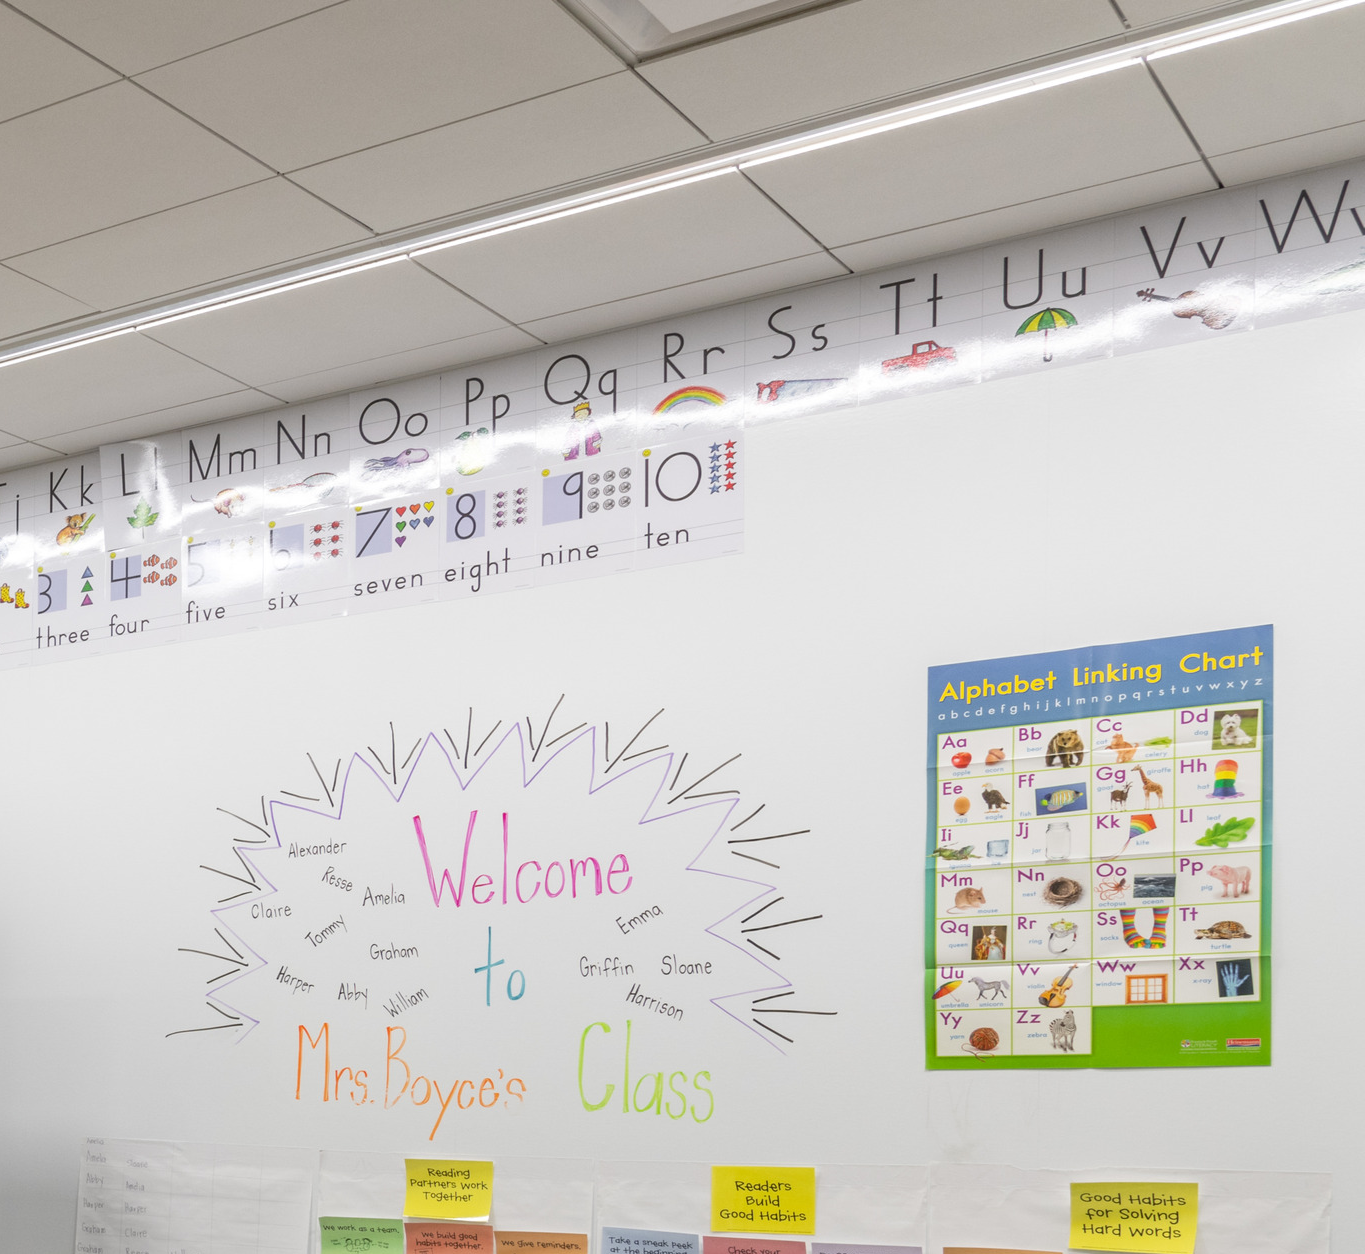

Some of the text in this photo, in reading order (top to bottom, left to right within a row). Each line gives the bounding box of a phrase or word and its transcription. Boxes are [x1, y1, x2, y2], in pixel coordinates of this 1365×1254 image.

[1139, 216, 1225, 280] Vv
[1003, 248, 1088, 310] Uu
[879, 273, 944, 336] Tt
[663, 332, 725, 383] Rr
[189, 434, 257, 482] Mm
[49, 465, 94, 513] Kk
[644, 451, 702, 508] 10
[644, 521, 690, 549] ten
[541, 543, 599, 567] nine
[444, 547, 511, 592] eight
[354, 571, 423, 596] seven
[186, 600, 226, 625] five
[268, 592, 299, 611] six
[109, 613, 150, 637] four
[37, 626, 90, 650] three
[938, 646, 1263, 704] Alphabet Linking Chart
[942, 736, 967, 748] Aa
[1019, 727, 1042, 740] Bb
[1180, 759, 1207, 773] Hh
[288, 838, 346, 858] Alexander
[413, 810, 633, 907] Welcome
[322, 866, 353, 891] Resse
[363, 883, 405, 906] Amelia
[251, 903, 292, 919] Claire
[615, 904, 663, 936] Emma
[1018, 916, 1037, 929] Rr
[305, 915, 347, 947] Tommy
[370, 943, 418, 960] Graham
[473, 925, 527, 1006] to
[579, 956, 635, 978] Griffin
[660, 956, 713, 976] Sloane
[276, 966, 314, 994] Harper
[338, 983, 368, 1010] Abby
[383, 988, 429, 1017] William
[625, 983, 684, 1020] Harrison
[384, 1026, 526, 1140] Boyce's
[577, 1020, 714, 1124] Class
[410, 1179, 456, 1189] Partners
[428, 1168, 470, 1179] Reading
[735, 1180, 791, 1191] Readers
[423, 1191, 473, 1202] Together
[746, 1196, 780, 1207] Build
[1080, 1192, 1186, 1206] Good Habits
[720, 1209, 807, 1221] Good Habits
[1086, 1208, 1179, 1223] for Solving
[437, 1231, 456, 1239] build
[459, 1232, 477, 1240] good
[1082, 1223, 1121, 1237] Hard
[416, 1239, 483, 1249] habits together.
[518, 1240, 534, 1248] give
[537, 1241, 581, 1250] reminders.
[624, 1247, 641, 1254] the
